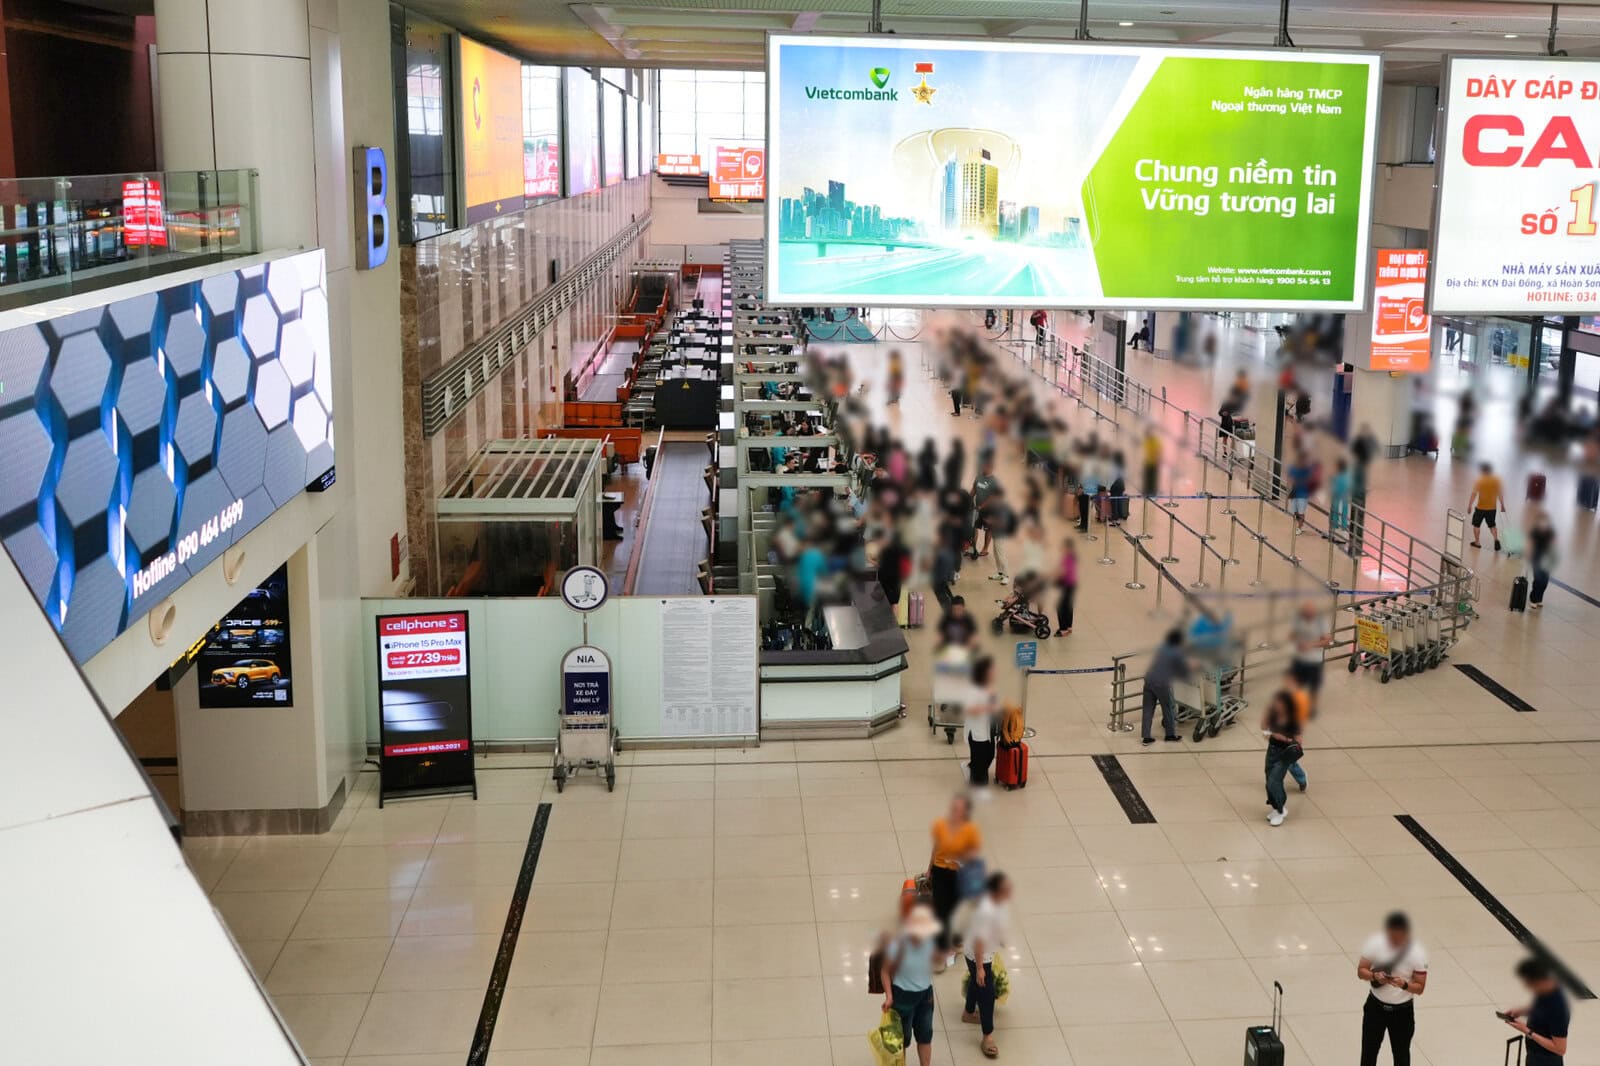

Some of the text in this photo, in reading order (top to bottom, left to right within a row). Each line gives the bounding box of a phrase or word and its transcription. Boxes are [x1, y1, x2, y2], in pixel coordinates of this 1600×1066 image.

[805, 86, 898, 102] Vietcombank
[1244, 86, 1342, 100] Ngân hàng TMCP
[1466, 74, 1600, 100] DÂY CÁP Đ
[1212, 100, 1342, 114] Ngoại thương Việt Nam
[1462, 114, 1600, 168] CA
[1135, 158, 1337, 187] Chung niềm tin
[367, 147, 389, 269] B
[1140, 188, 1335, 217] Vững tương lai
[1521, 183, 1597, 236] SỐ 1
[1502, 262, 1525, 275] NHÀ
[1528, 262, 1552, 275] MÁY
[1555, 261, 1576, 275] SẢN
[1446, 278, 1460, 288] Địa
[1482, 279, 1499, 287] KCN
[1560, 277, 1582, 287] Hoàn
[1527, 292, 1597, 302] HOTLINE: 034
[133, 498, 244, 599] Hotline 090 464 6699
[386, 618, 458, 632] cellphone S
[391, 641, 420, 649] iPhone
[421, 640, 429, 648] 15
[407, 652, 440, 664] 27.39
[577, 655, 595, 663] NIA
